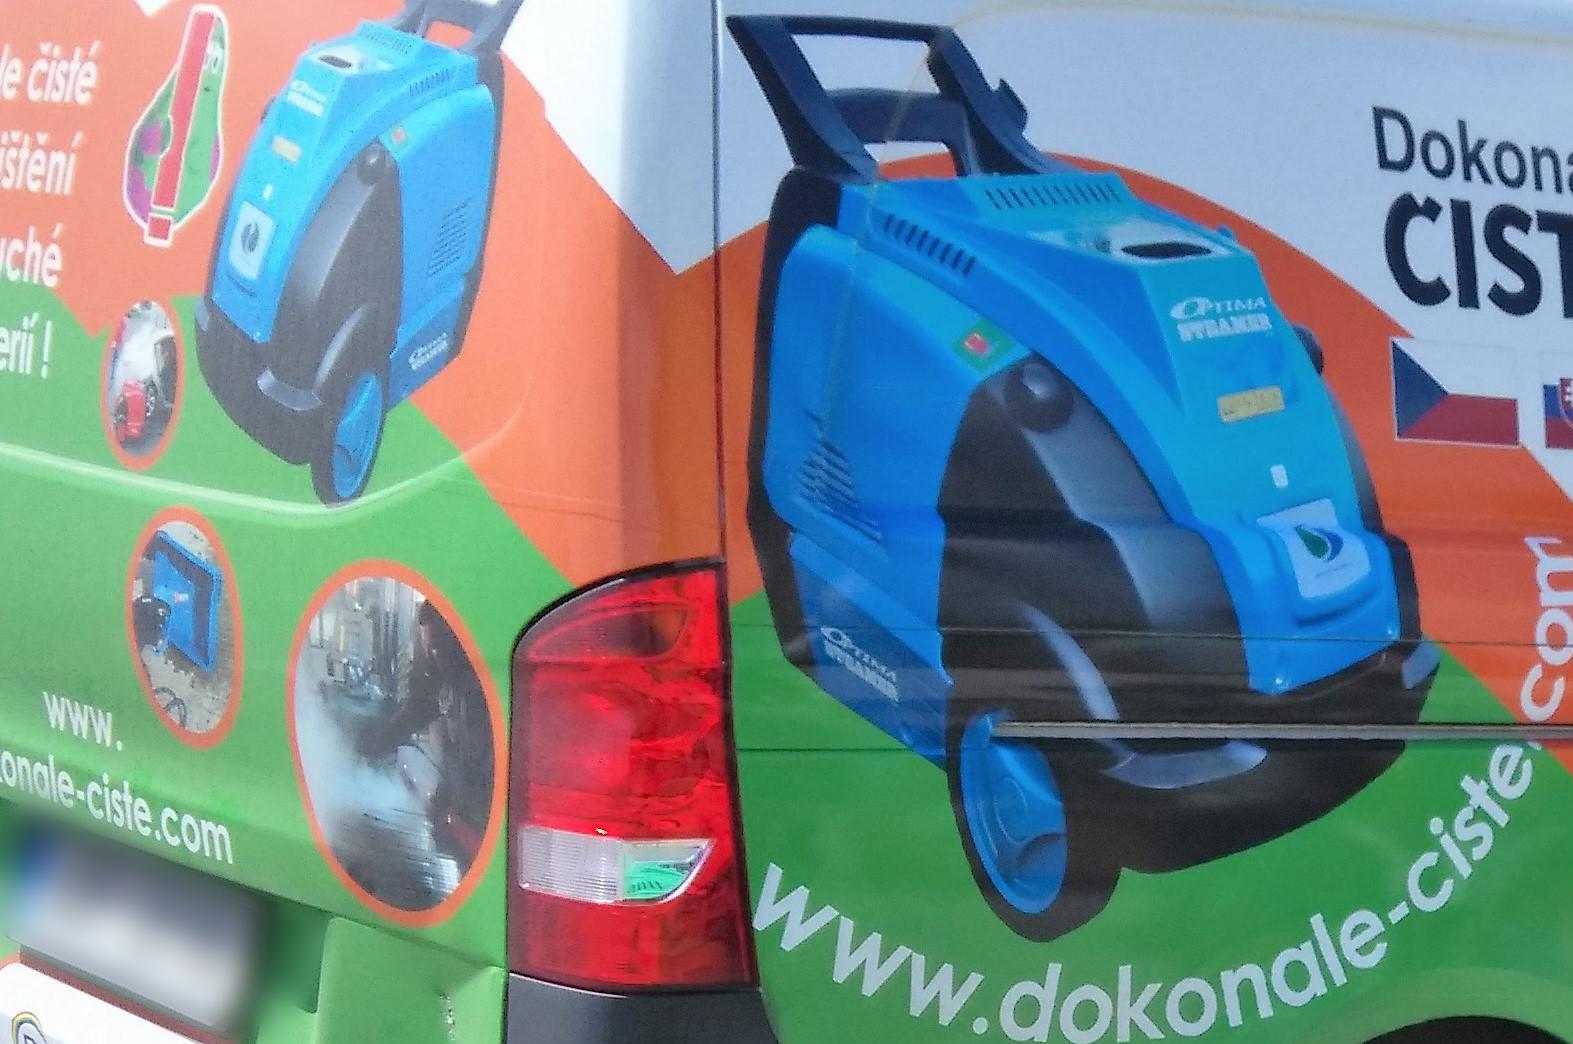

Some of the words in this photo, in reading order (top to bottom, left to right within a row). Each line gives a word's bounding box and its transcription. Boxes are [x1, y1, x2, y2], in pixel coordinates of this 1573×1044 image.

[27, 39, 101, 104] čisté
[43, 691, 123, 751] www.
[0, 750, 233, 864] onale-ciste.com
